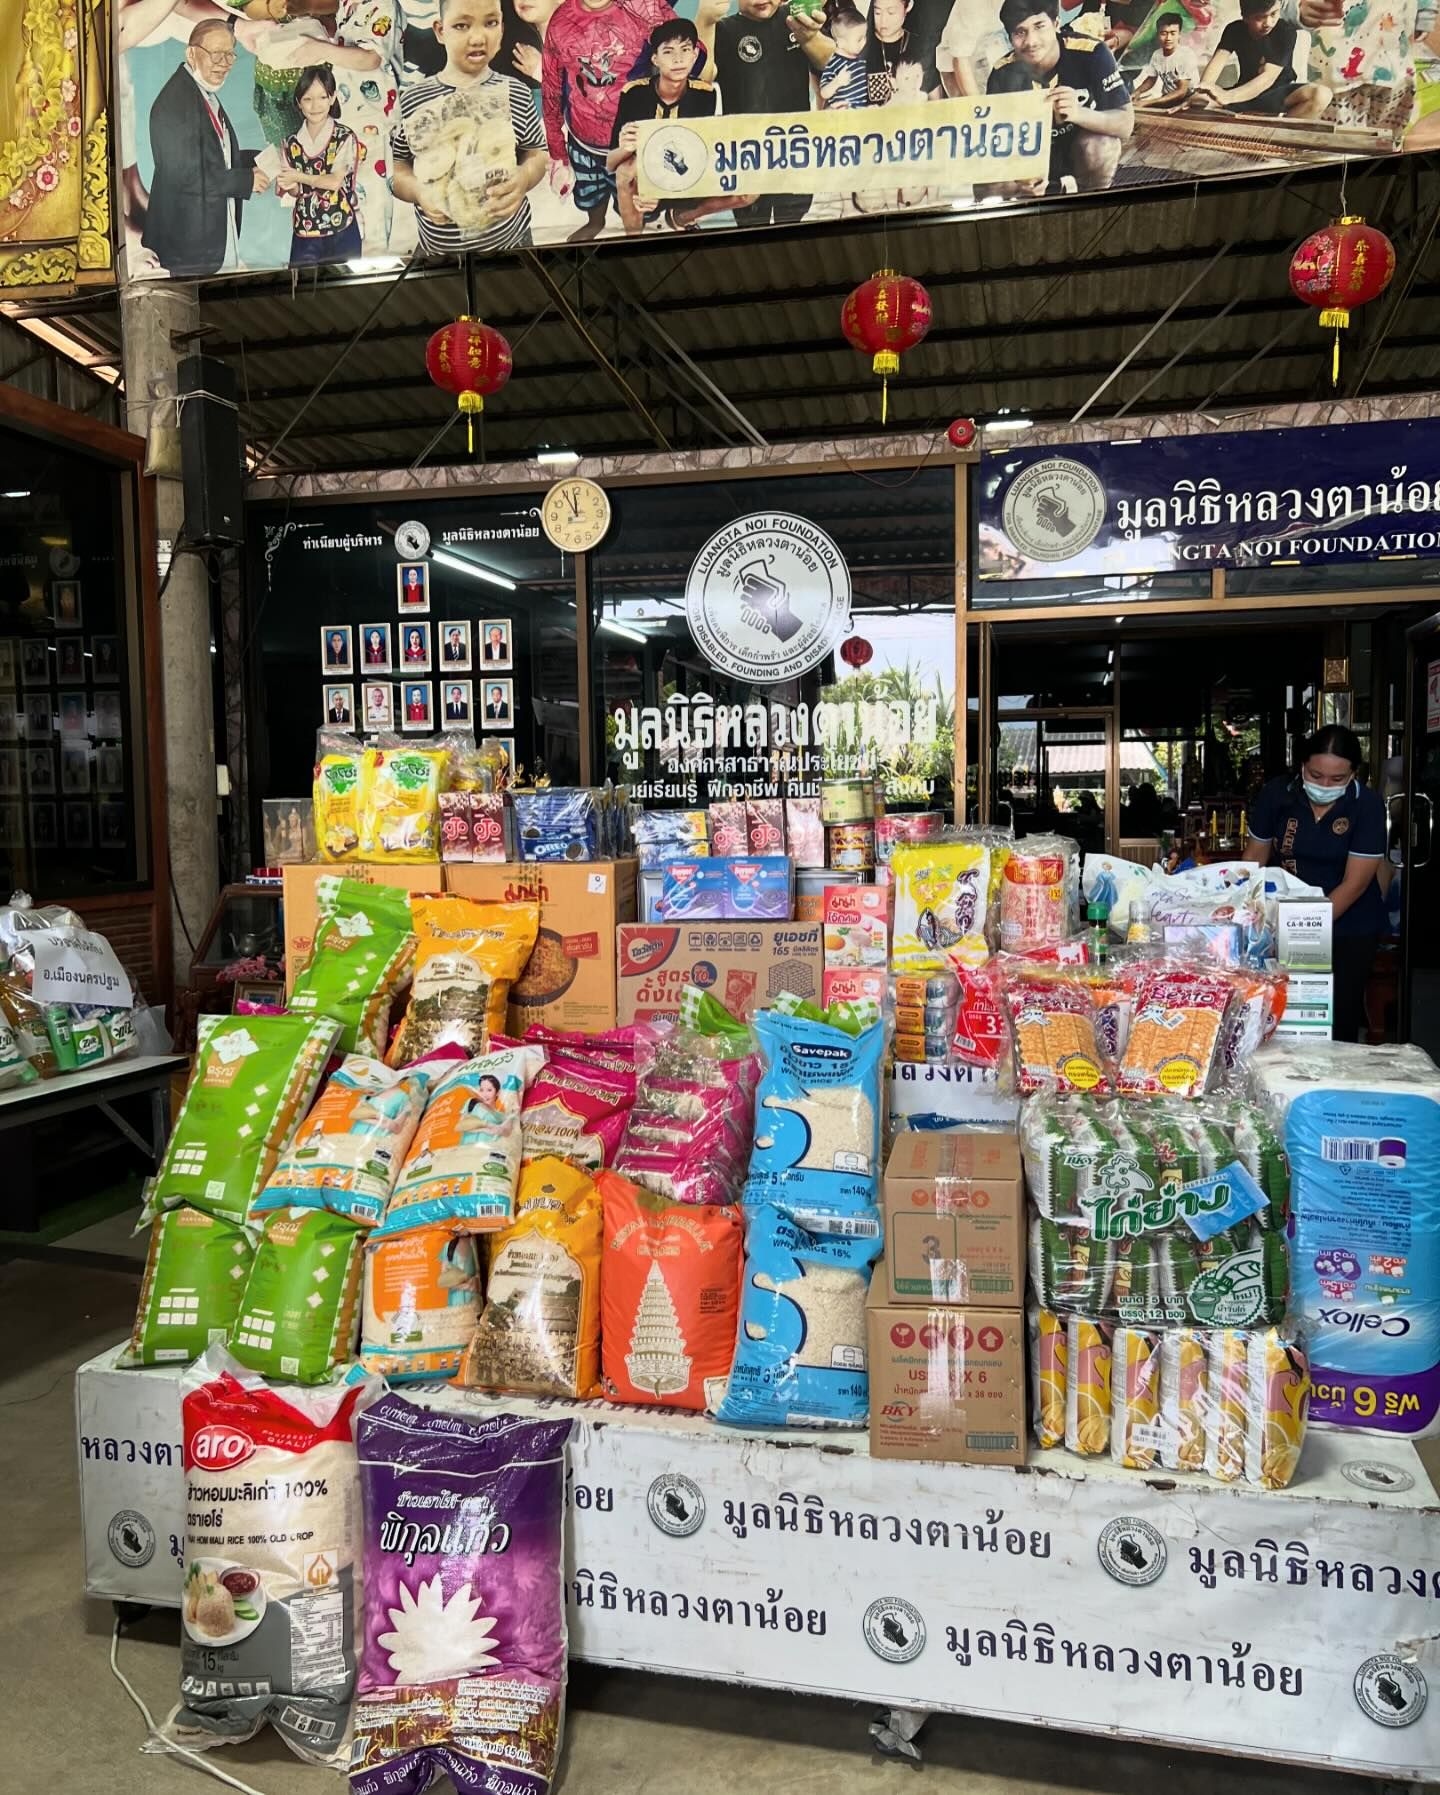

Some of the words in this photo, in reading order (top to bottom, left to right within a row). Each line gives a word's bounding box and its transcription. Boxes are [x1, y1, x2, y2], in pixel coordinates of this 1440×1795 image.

[714, 106, 1042, 192] มูลนิธิหลวงตาน้อย
[303, 534, 382, 552] ทำเนียบผู้บริหาร
[443, 525, 539, 544] มูลนิธิหลวงตาน้อย
[697, 527, 742, 574] LUANGTA
[745, 519, 767, 531] NOI
[772, 518, 838, 569] FOUNDATION
[717, 537, 819, 577] มูลนิธิหลวงตาน้อย
[1238, 540, 1282, 557] NOI
[731, 662, 780, 677] FOUNDING
[784, 662, 803, 674] AND
[534, 843, 568, 855] OREO
[773, 929, 819, 947] ยูเอชที
[773, 947, 789, 956] 165
[44, 966, 119, 991] อ.เมืองนครปฐม
[656, 969, 690, 988] สูตร
[1152, 985, 1214, 1002] Bento
[793, 1044, 848, 1058] Savepak
[771, 1171, 778, 1185] 5
[852, 1185, 865, 1196] 140
[1080, 1182, 1230, 1241] ไก่ย่าง
[832, 1247, 852, 1259] 15%
[1333, 1251, 1341, 1262] 3
[1384, 1257, 1392, 1267] 2
[1151, 1296, 1158, 1305] 5
[1166, 1296, 1184, 1305] บาท
[1121, 1309, 1145, 1321] บรรจุ
[1149, 1310, 1163, 1319] 12
[1167, 1310, 1185, 1319] ซอง
[1319, 1308, 1410, 1337] Cellox
[978, 1371, 987, 1384] 6
[850, 1384, 863, 1397] 140
[1353, 1386, 1377, 1417] 6
[1385, 1391, 1420, 1416] ฟรี
[880, 1404, 919, 1417] BKY
[196, 1435, 247, 1459] aro
[285, 1479, 328, 1498] 100%
[187, 1508, 223, 1527] ตราเอโร่
[723, 1492, 1051, 1558] มูลนิธิหลวงตาน้อย
[209, 1535, 225, 1544] MALI
[227, 1535, 245, 1544] RICE
[248, 1535, 267, 1544] 100%
[270, 1534, 287, 1543] OLD
[379, 1511, 510, 1567] พิกุลแก้ว
[201, 1651, 216, 1672] 15
[945, 1619, 1303, 1697] มูลนิธิหลวงตาน้อย
[505, 1748, 517, 1758] 15
